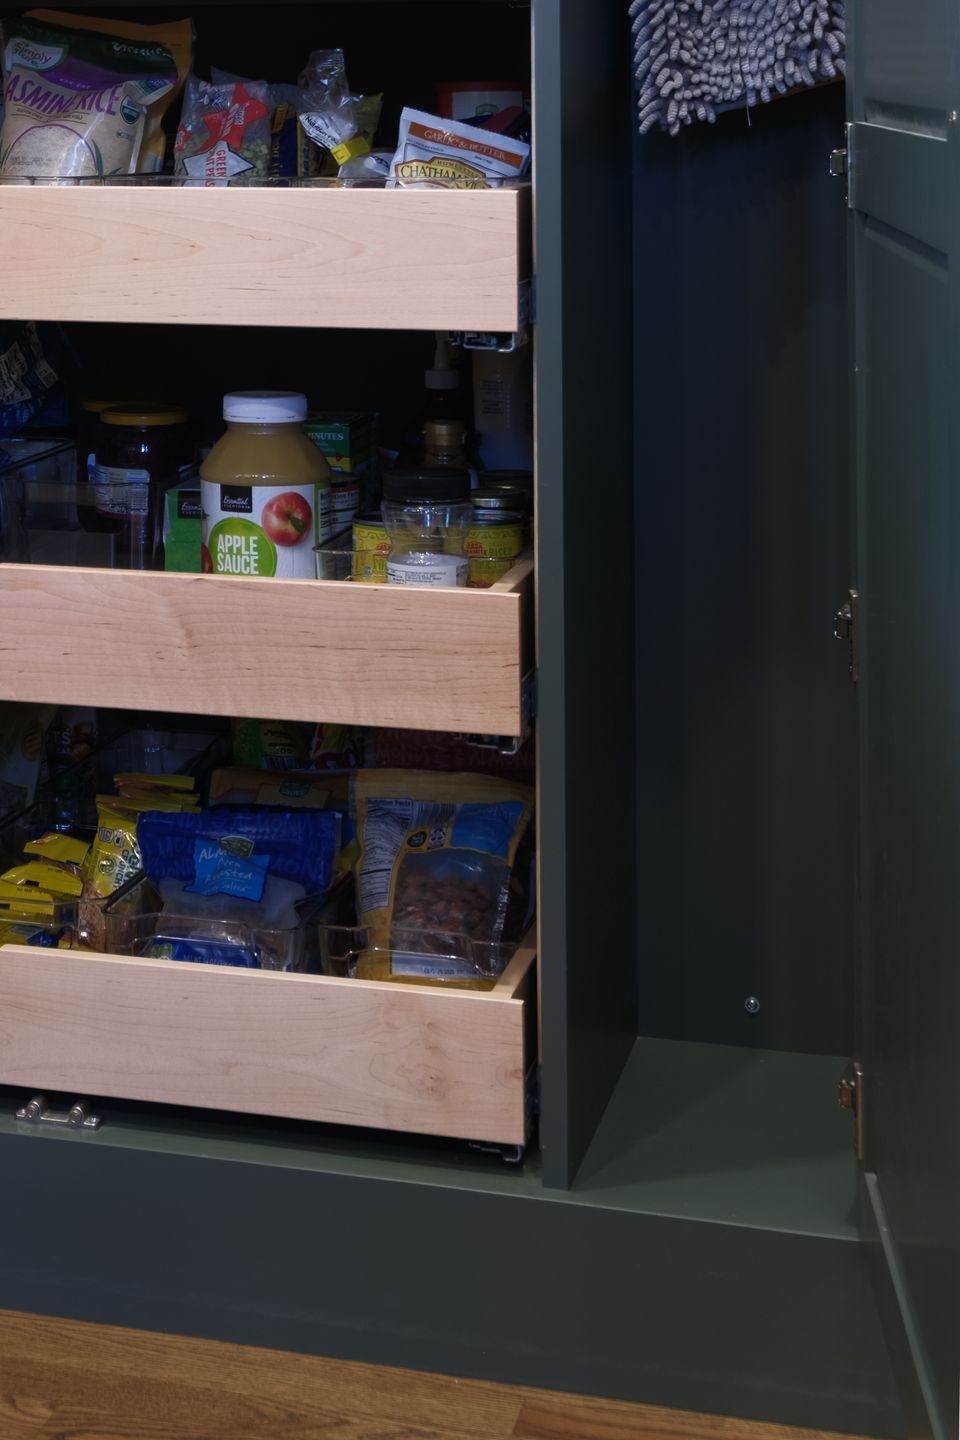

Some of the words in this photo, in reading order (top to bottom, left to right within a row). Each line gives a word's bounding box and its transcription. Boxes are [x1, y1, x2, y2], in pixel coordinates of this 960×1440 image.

[215, 149, 228, 177] GREEN
[217, 534, 259, 556] APPLE
[217, 554, 259, 575] SAUCE
[395, 799, 412, 808] Facts
